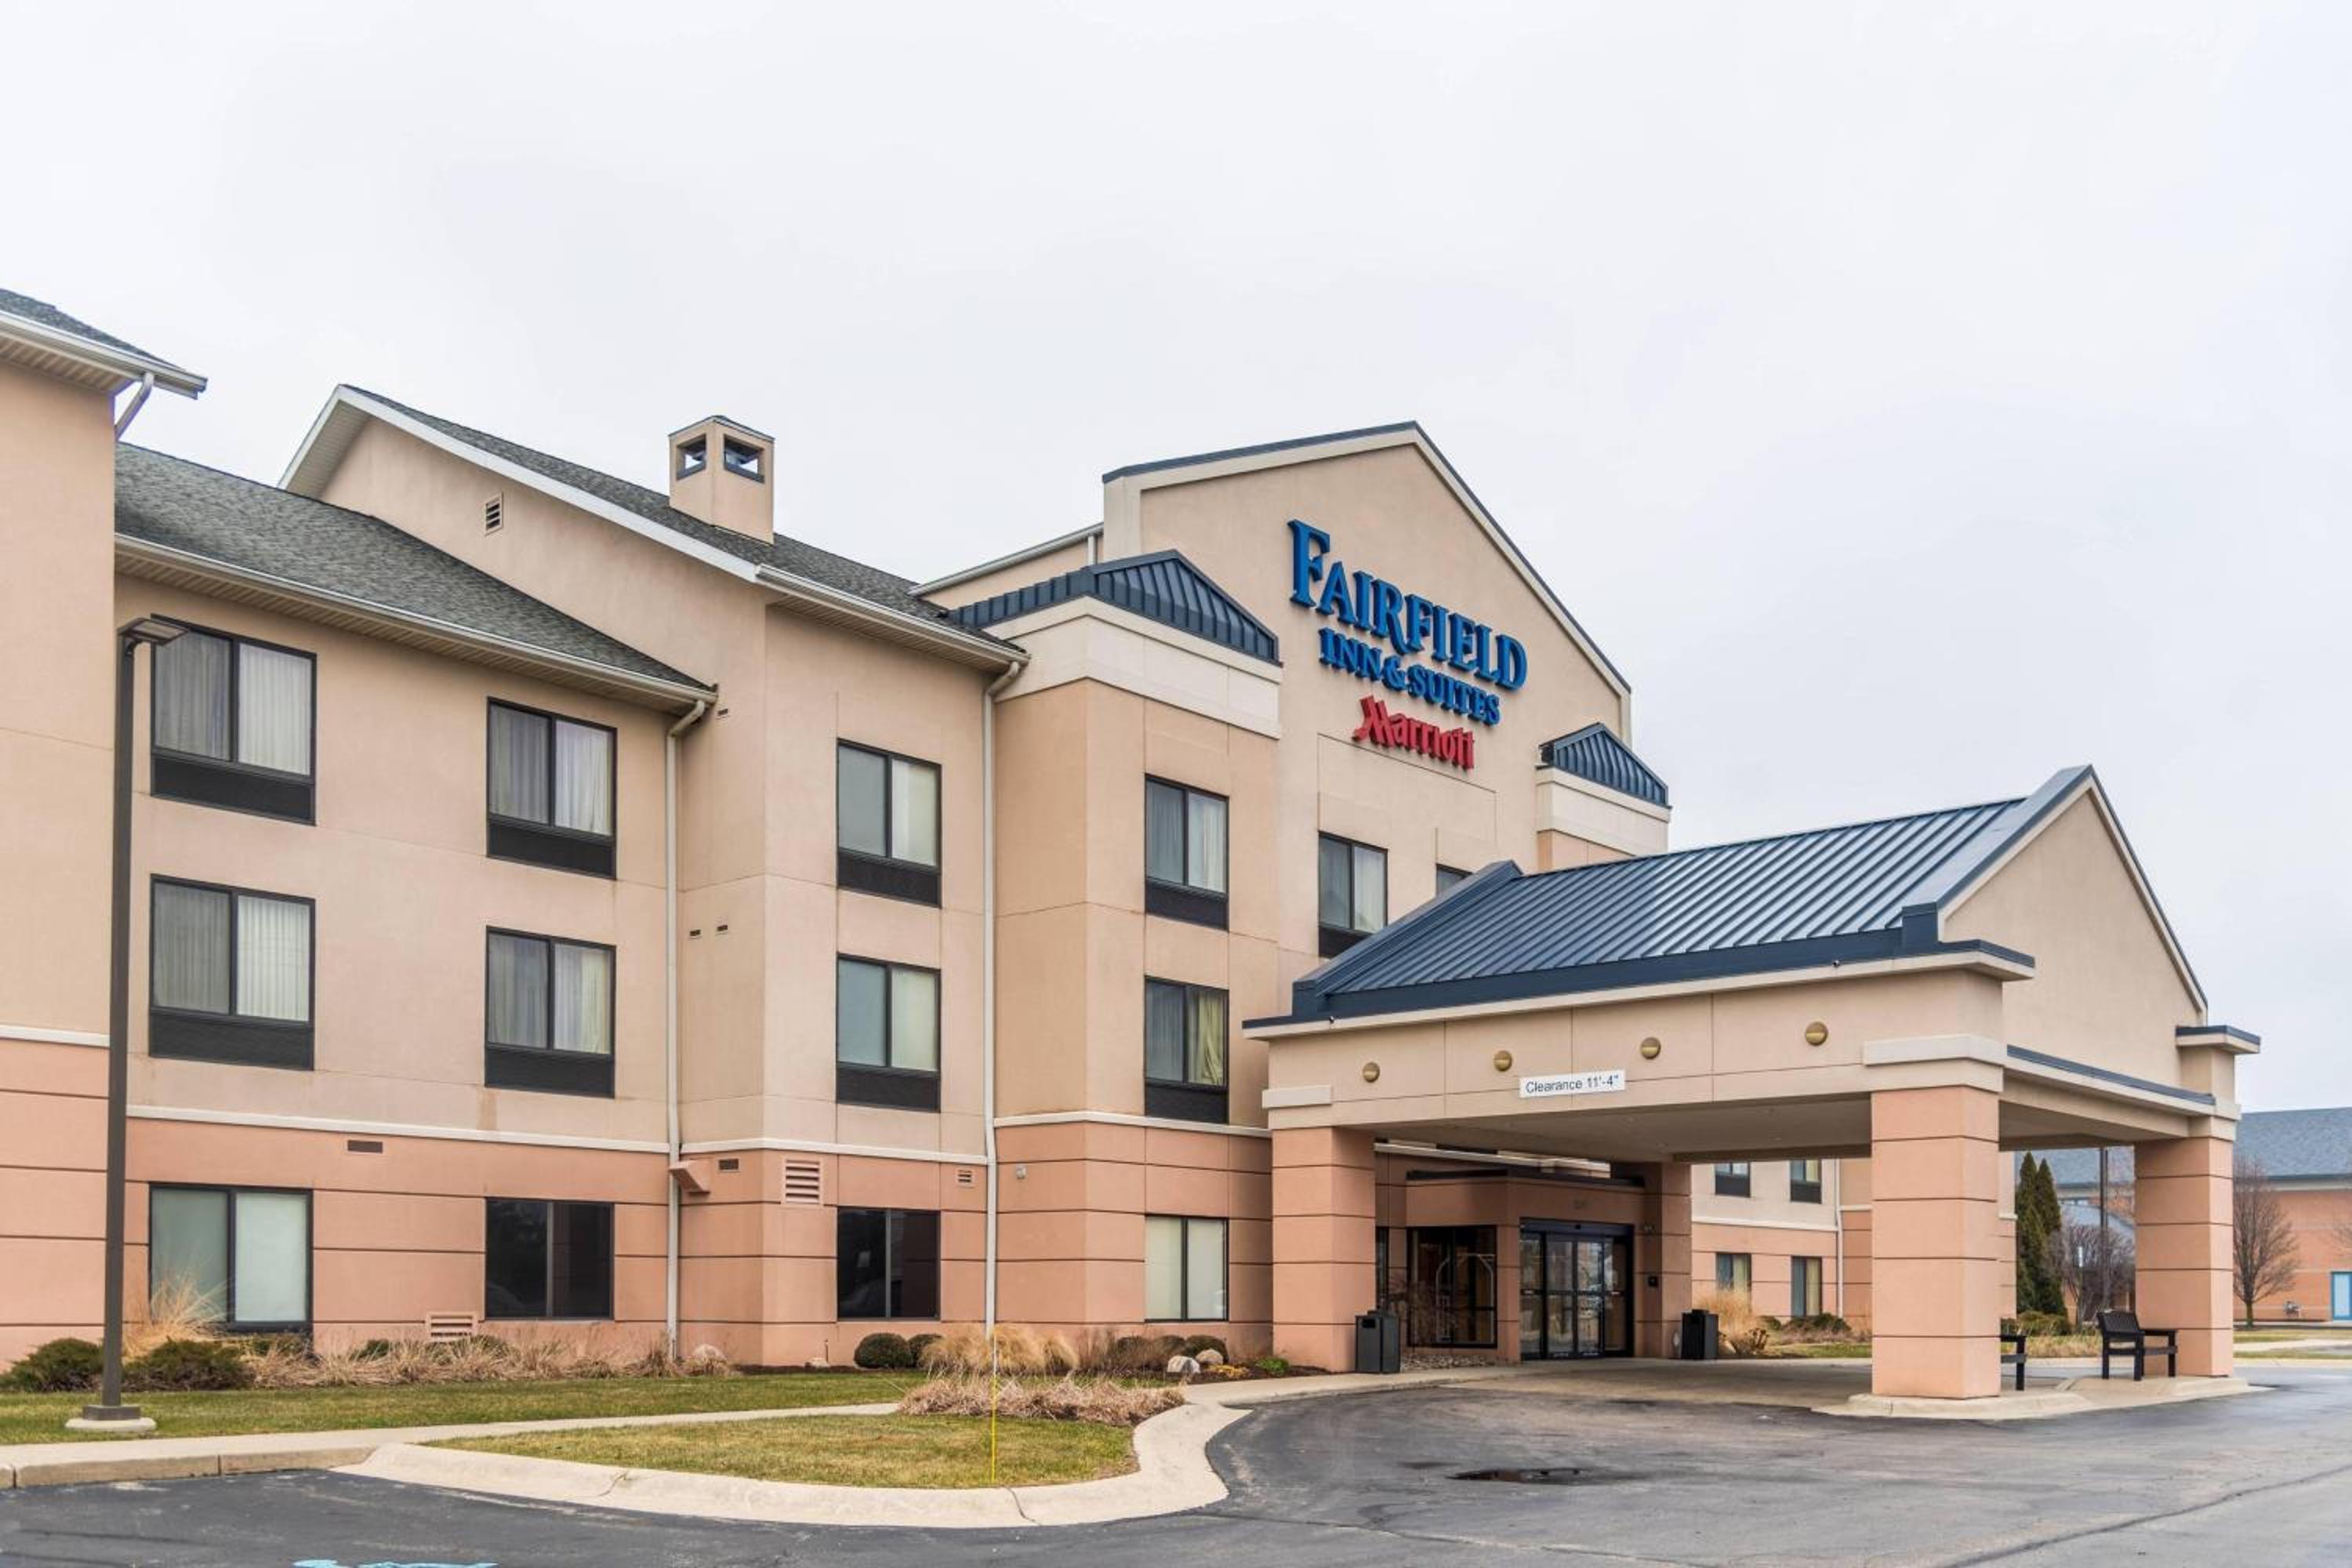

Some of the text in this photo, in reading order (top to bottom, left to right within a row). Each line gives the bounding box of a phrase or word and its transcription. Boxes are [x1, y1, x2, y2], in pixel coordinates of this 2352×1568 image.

[1287, 519, 1527, 691] FAIRFIELD
[1352, 695, 1475, 770] Marriott
[1525, 1080, 1583, 1093] Clearance
